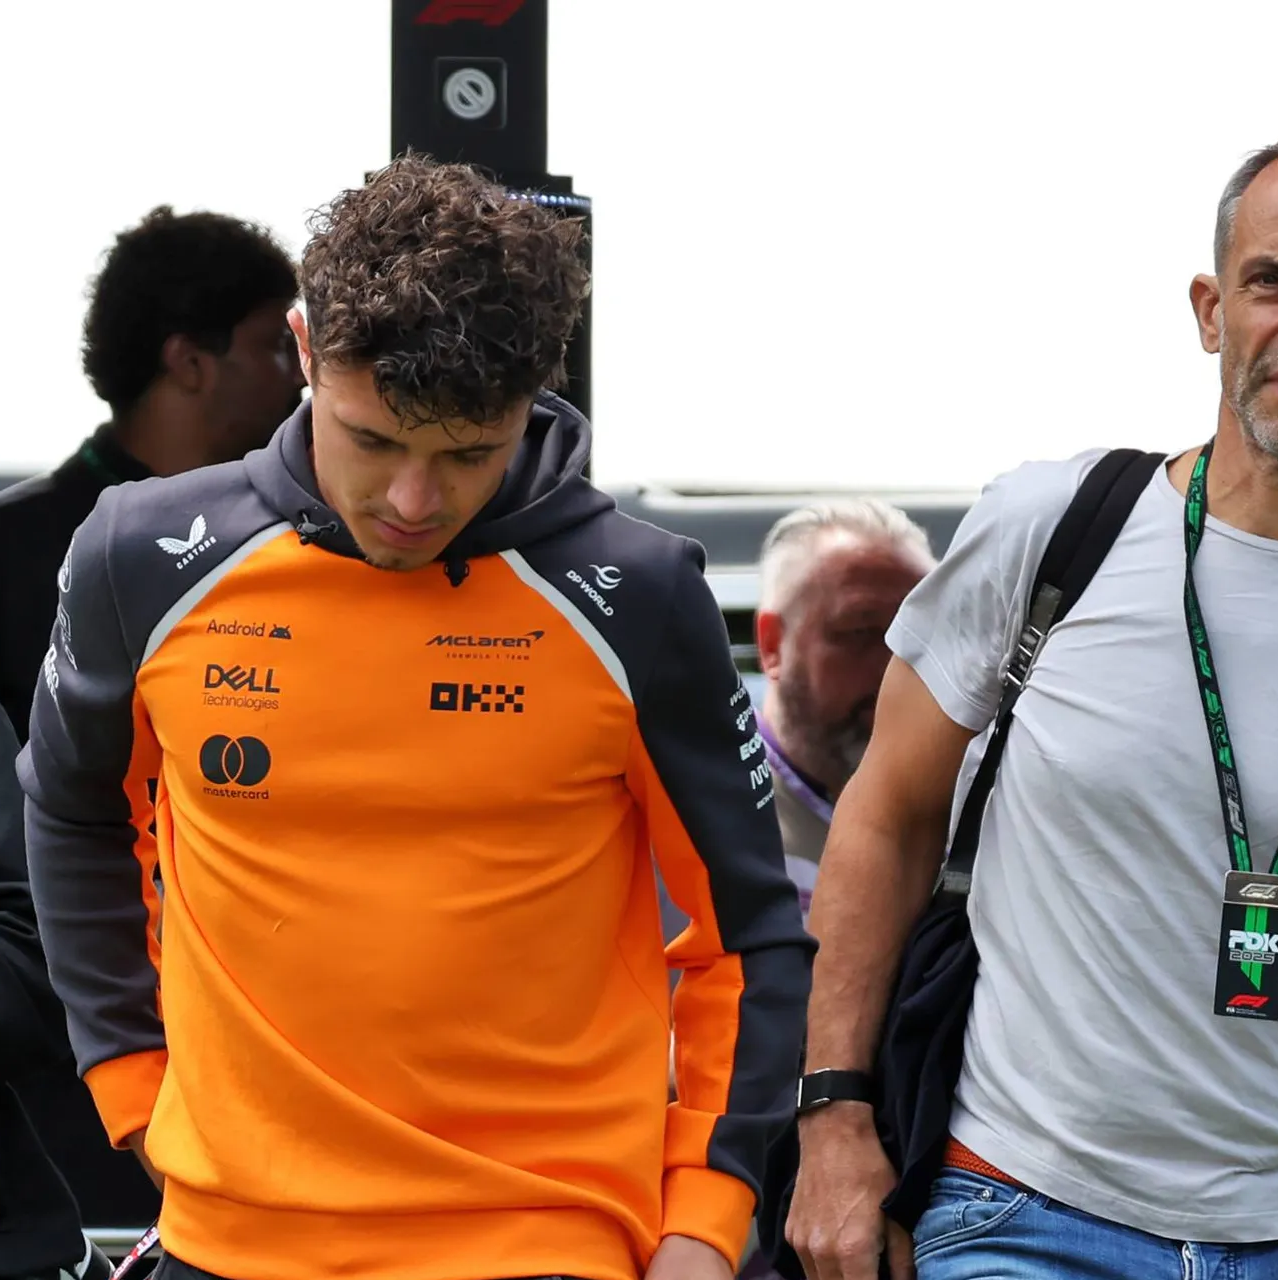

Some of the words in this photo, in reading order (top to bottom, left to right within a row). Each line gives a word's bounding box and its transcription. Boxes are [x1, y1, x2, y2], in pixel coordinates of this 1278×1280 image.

[176, 536, 217, 570] CASTORE
[565, 569, 582, 584] DP
[580, 580, 614, 616] WORLD
[206, 619, 266, 637] Android
[425, 634, 531, 648] McLaren
[204, 664, 280, 693] DELL
[202, 692, 279, 711] Technologies
[430, 682, 525, 713] OKX
[203, 786, 269, 800] mastercard
[1230, 950, 1275, 965] 2025
